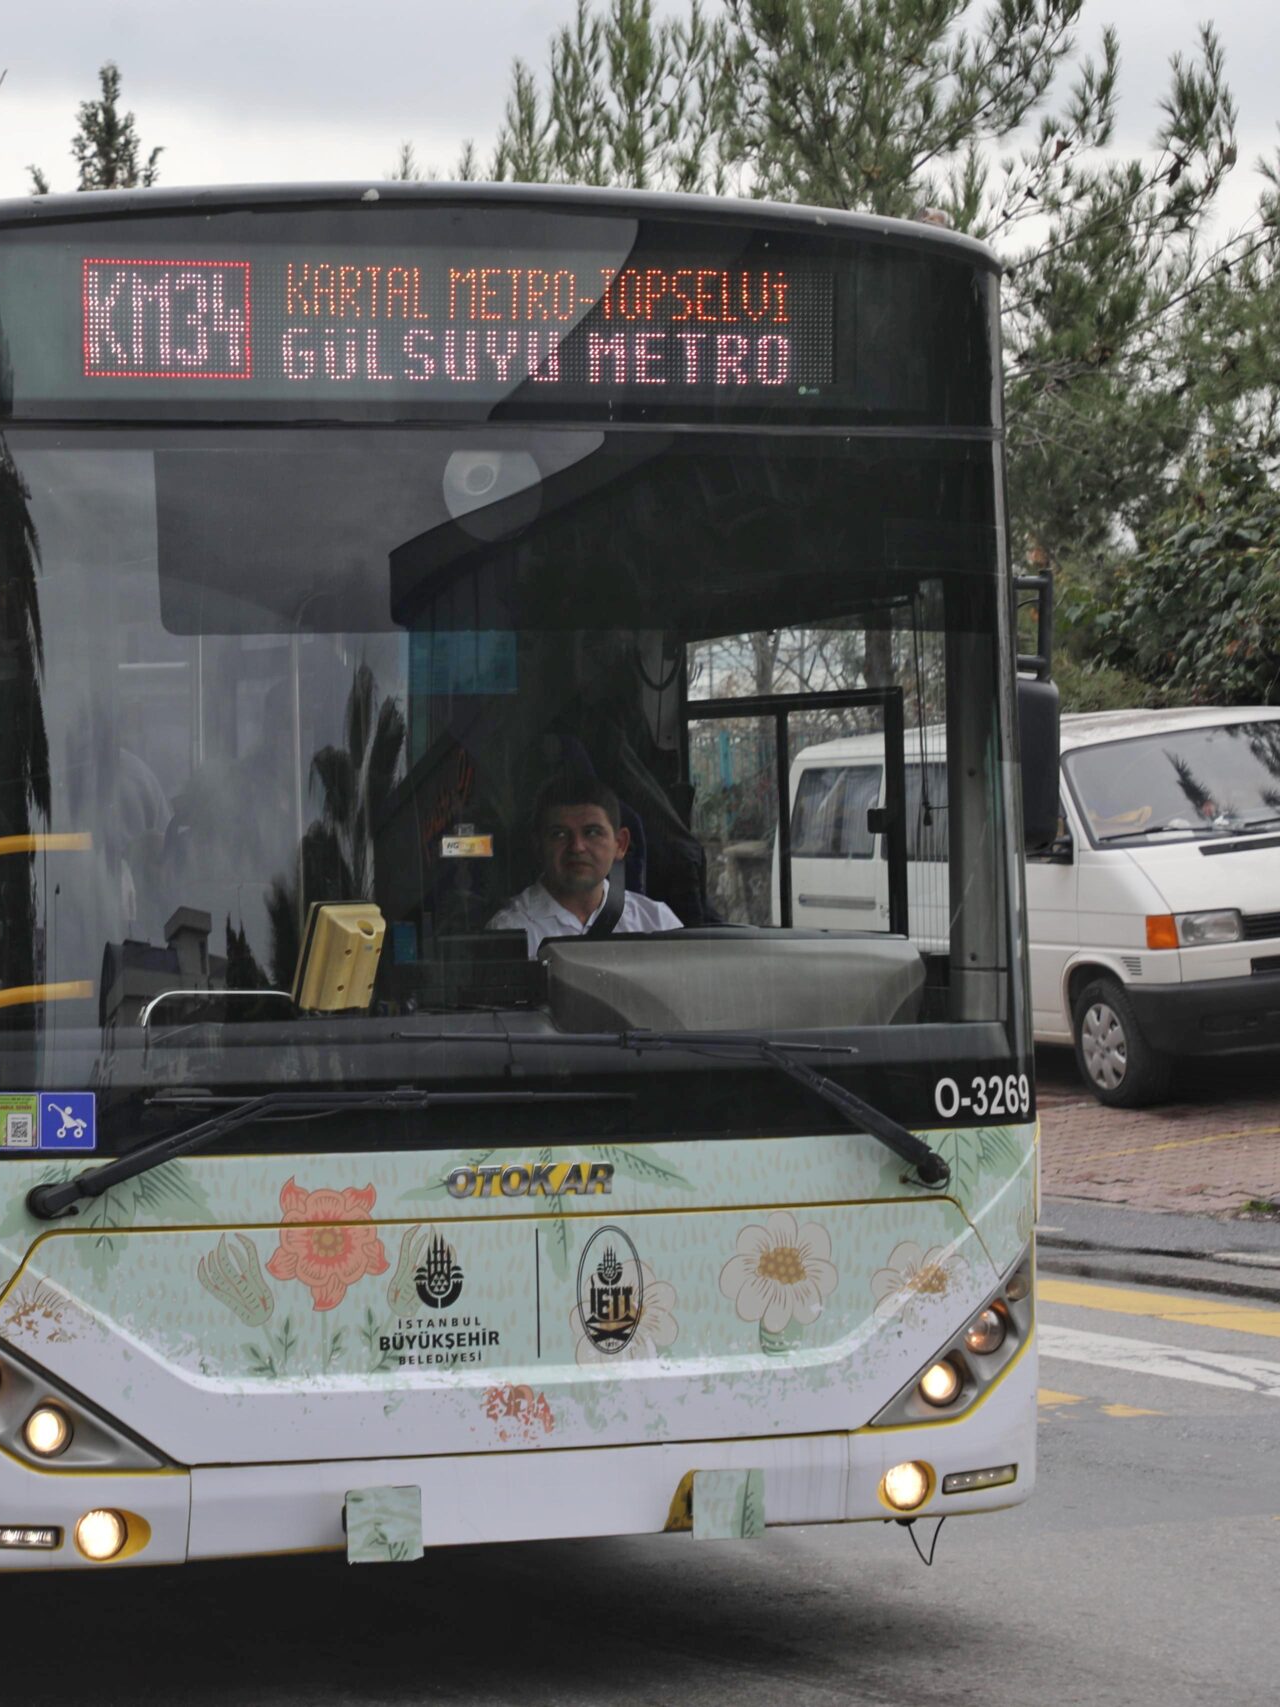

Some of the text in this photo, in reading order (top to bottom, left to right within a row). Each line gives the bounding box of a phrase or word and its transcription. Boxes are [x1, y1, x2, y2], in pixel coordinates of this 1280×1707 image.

[287, 263, 429, 319] KARTAL
[88, 270, 246, 366] KM34
[282, 327, 789, 385] GÜLSUYU METRO
[934, 1073, 1031, 1118] O-3269
[446, 1161, 615, 1199] OTOKAR
[379, 1328, 500, 1351] BÜYÜKŞEHİR
[398, 1316, 481, 1329] İSTANBUL
[399, 1351, 482, 1366] BELEDİYESİ
